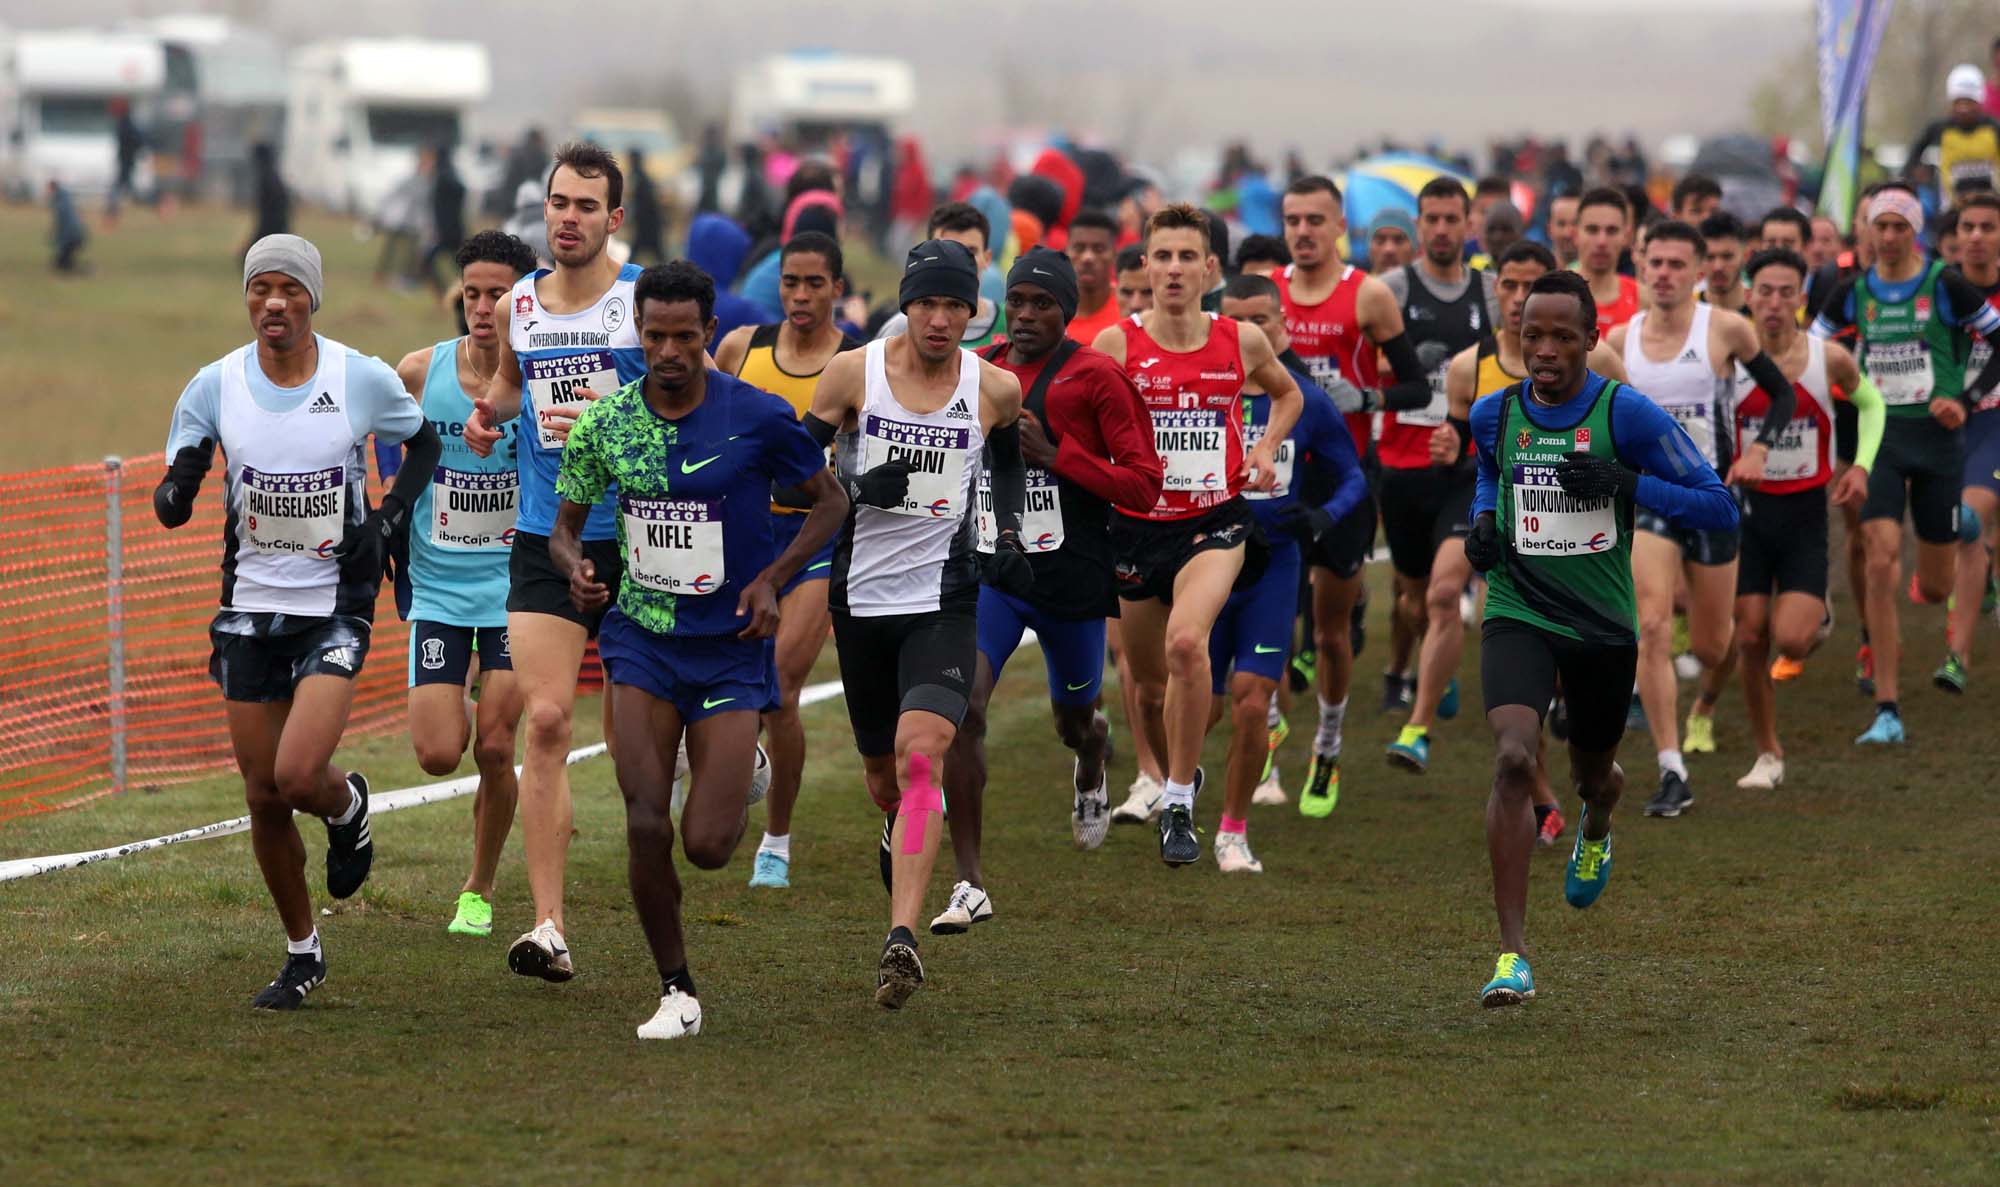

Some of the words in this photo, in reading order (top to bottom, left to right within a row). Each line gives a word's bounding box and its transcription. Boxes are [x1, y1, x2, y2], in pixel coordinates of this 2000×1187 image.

[529, 332, 569, 347] UNIVERSIDAD
[570, 332, 580, 346] DE
[581, 332, 610, 346] BURGOS
[532, 353, 600, 370] DIPUTACIÓN
[534, 362, 603, 379] BURGOS
[309, 405, 340, 413] adidas
[946, 410, 973, 421] adidas
[879, 420, 959, 438] DIPUTACIÓN
[1153, 418, 1217, 427] URGOS
[878, 429, 957, 448] BURGOS
[1155, 431, 1219, 450] IMENEZ
[1537, 437, 1567, 446] Joma
[252, 470, 332, 483] DIPUTACIÓN
[445, 469, 518, 481] DIPUTACIÓN
[252, 479, 332, 492] BURGOS
[444, 478, 518, 490] BURGOS
[249, 490, 339, 518] HAILESELASSIE
[449, 490, 514, 513] OUMAIZ
[629, 499, 708, 511] DIPUTACIÓN
[440, 512, 448, 526] 5
[631, 507, 709, 522] BURGOS
[248, 516, 257, 530] 9
[981, 516, 988, 531] 3
[1522, 516, 1540, 532] 10
[250, 535, 304, 552] iberCaja
[439, 531, 491, 546] iberCaja
[646, 523, 693, 550] KIFLE
[1522, 538, 1577, 552] iberCaja
[634, 546, 641, 563] 1
[634, 568, 681, 589] iberCaja
